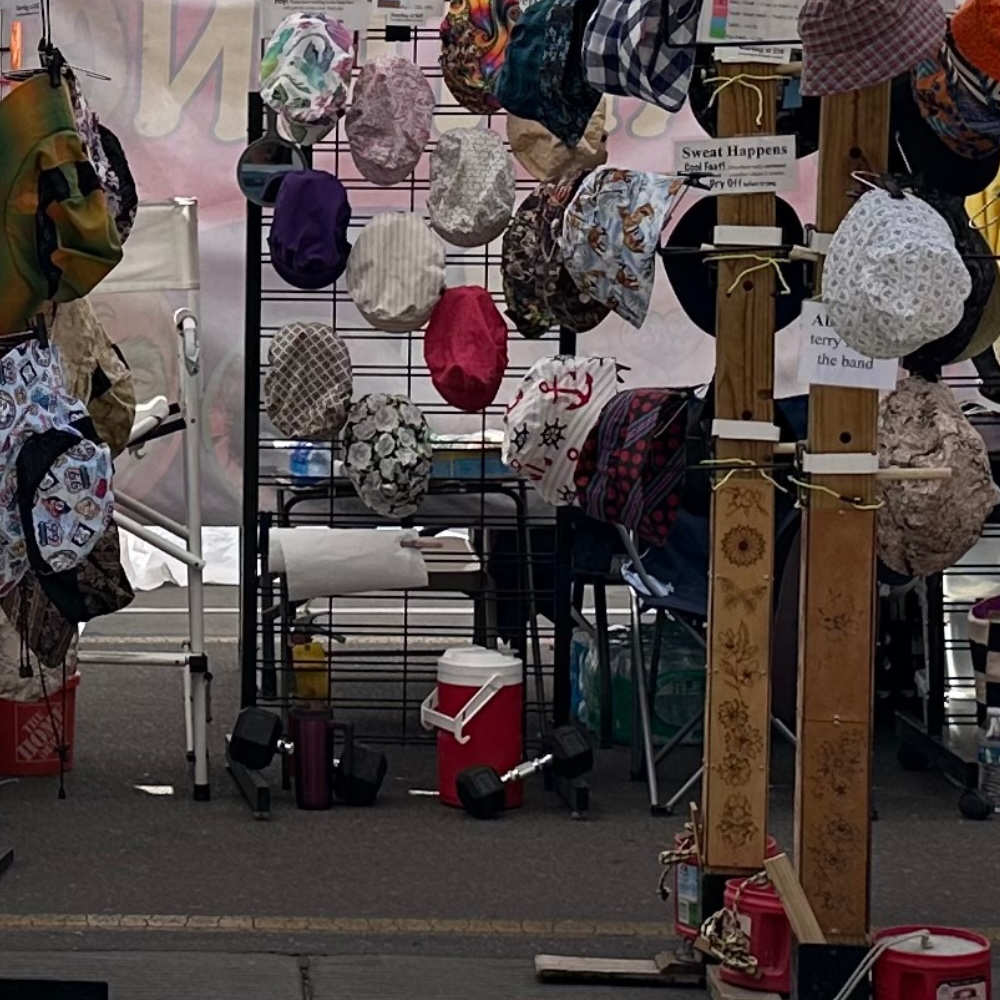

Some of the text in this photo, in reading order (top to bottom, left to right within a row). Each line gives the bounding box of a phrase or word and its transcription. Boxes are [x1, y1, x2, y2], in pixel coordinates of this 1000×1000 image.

[682, 145, 788, 159] Sweat Happens
[810, 334, 841, 349] terry
[817, 353, 874, 370] the band
